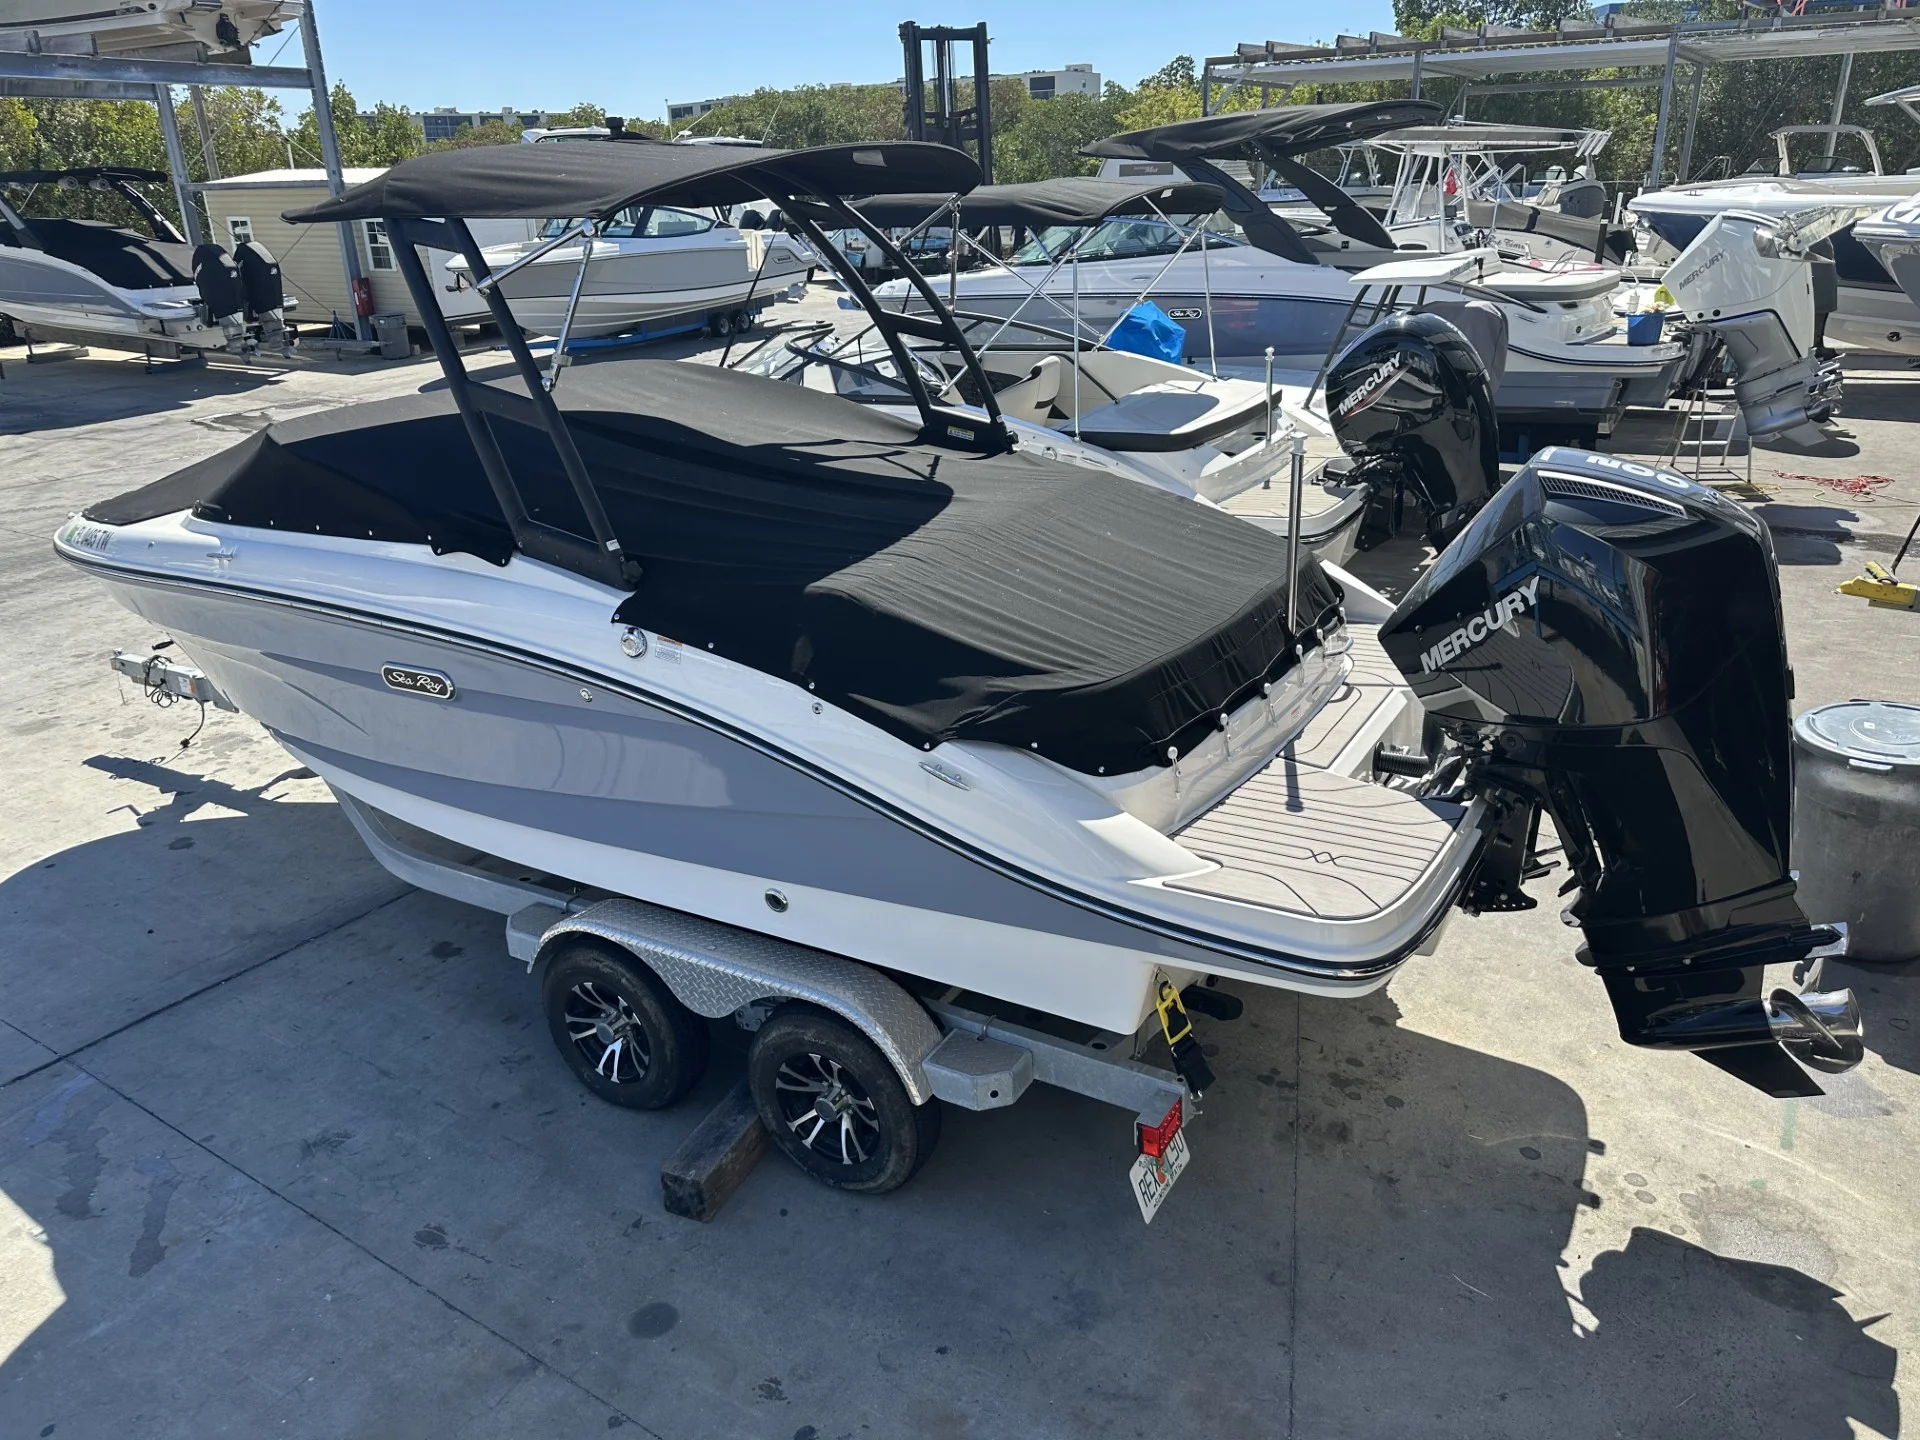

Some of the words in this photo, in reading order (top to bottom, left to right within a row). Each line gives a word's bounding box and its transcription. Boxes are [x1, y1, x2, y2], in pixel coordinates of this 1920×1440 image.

[1678, 249, 1725, 290] MERCURY
[1338, 352, 1401, 416] MERCURY
[1585, 455, 1690, 489] 200
[1420, 575, 1540, 675] MERCURY
[388, 671, 415, 685] Sea
[416, 675, 444, 693] Ray
[1138, 1163, 1161, 1208] REX
